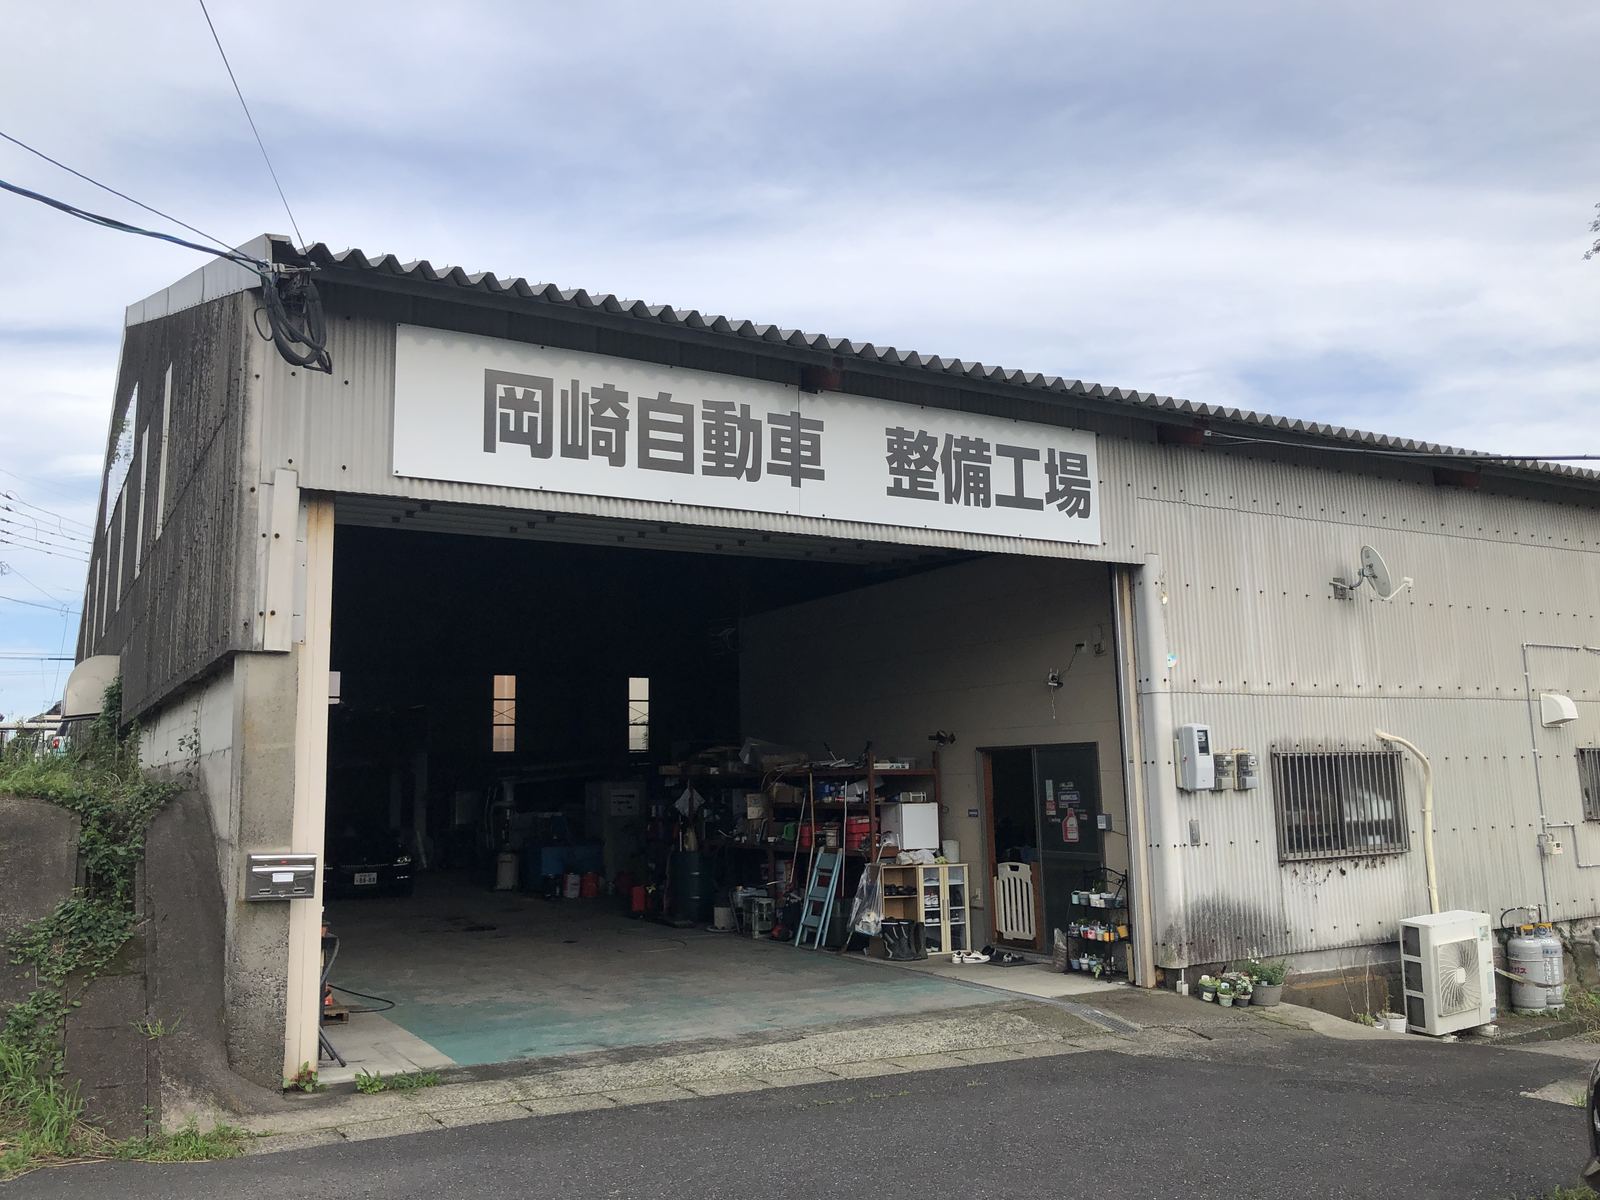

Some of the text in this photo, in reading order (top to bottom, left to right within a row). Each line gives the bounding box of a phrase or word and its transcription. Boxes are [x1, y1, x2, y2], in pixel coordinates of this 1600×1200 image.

[484, 369, 1091, 518] 岡崎自動車 整備工場
